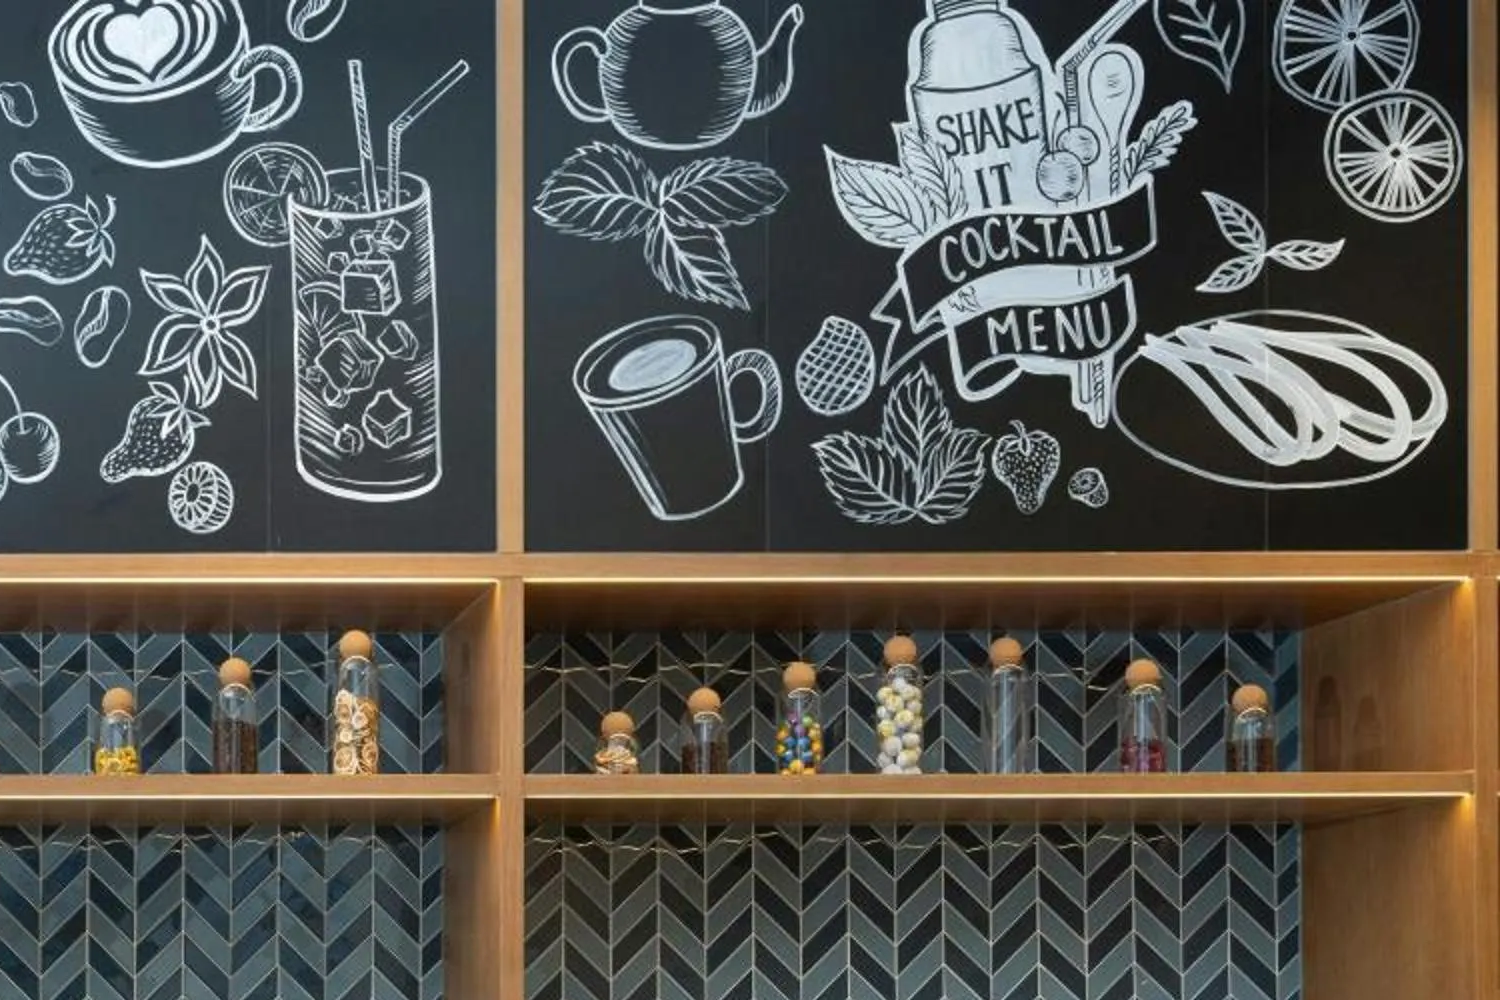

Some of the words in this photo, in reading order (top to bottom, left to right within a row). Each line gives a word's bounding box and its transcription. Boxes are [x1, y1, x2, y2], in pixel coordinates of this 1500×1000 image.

[936, 97, 1039, 158] SHAKE
[973, 162, 1012, 208] IT
[940, 209, 1123, 283] COCKTAIL
[986, 301, 1112, 355] MENU
